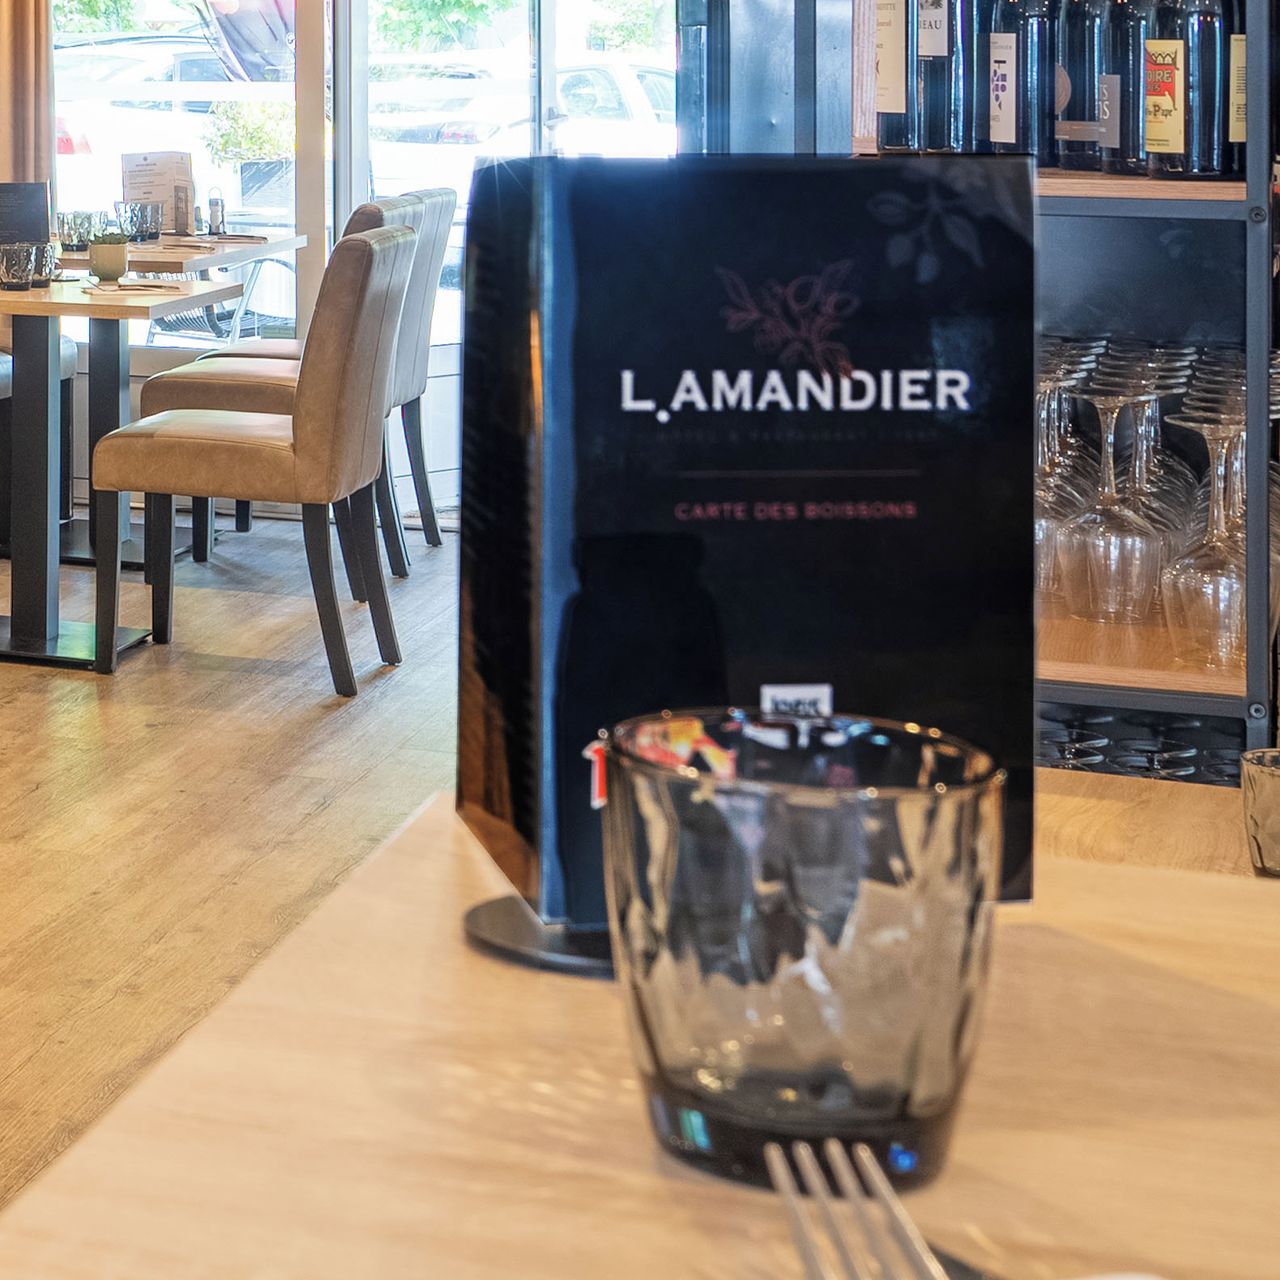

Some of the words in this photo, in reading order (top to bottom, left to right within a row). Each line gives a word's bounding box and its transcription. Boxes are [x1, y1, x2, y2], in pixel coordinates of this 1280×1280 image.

[674, 501, 748, 521] CARTE
[753, 501, 798, 521] DES
[803, 500, 919, 521] BOISSONS
